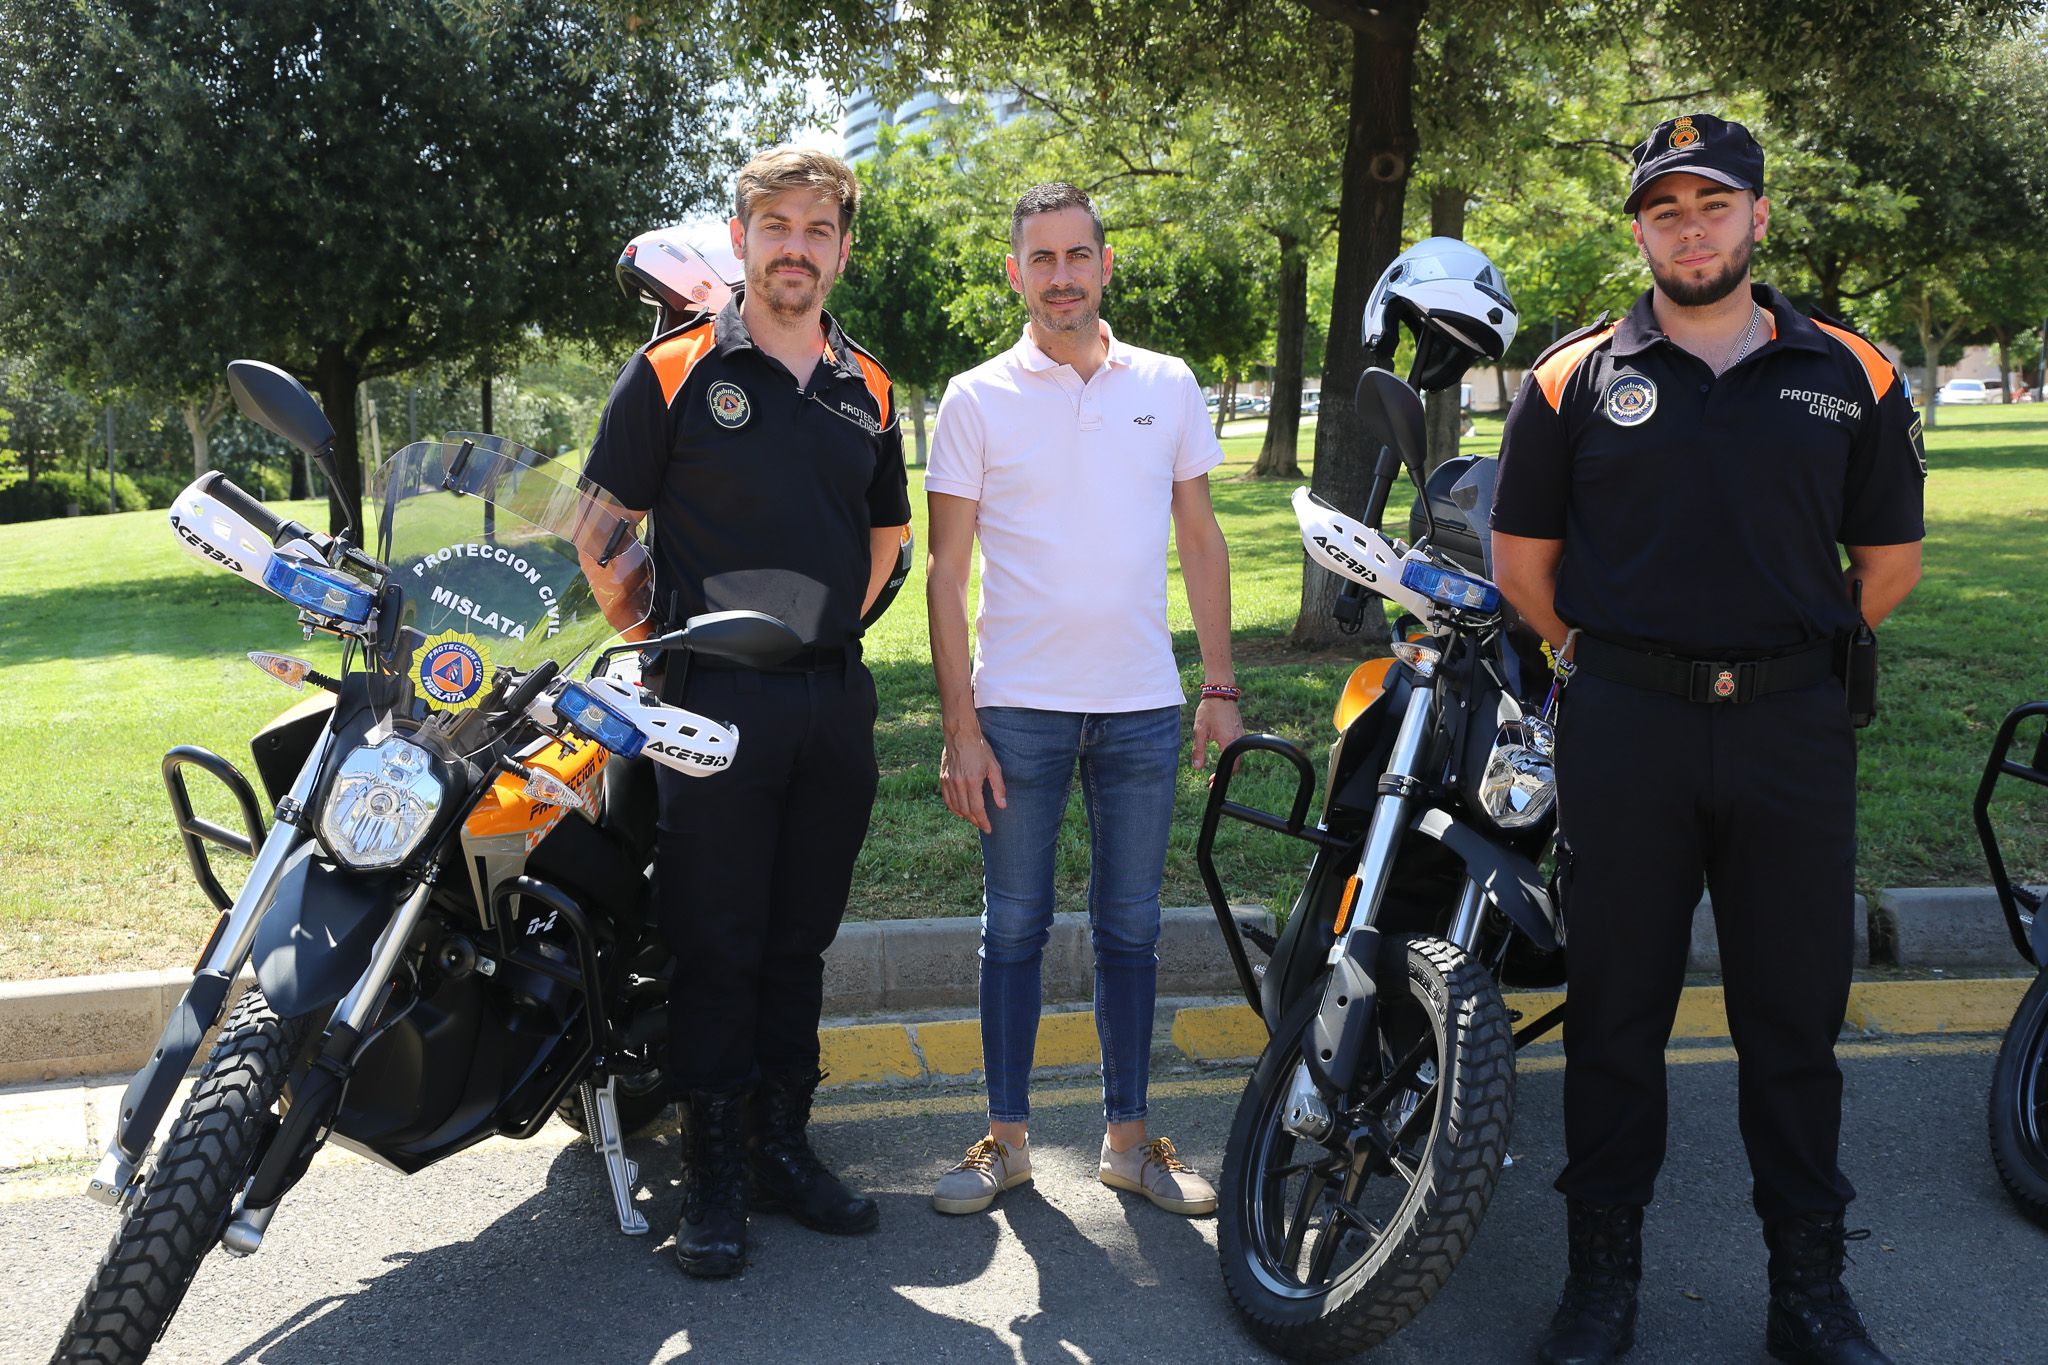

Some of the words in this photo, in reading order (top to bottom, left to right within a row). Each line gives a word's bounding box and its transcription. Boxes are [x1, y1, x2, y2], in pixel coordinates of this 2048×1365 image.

[1808, 403, 1841, 423] CIVIL
[170, 515, 243, 572] ACERBIS
[1312, 536, 1378, 583] ACERBIS
[412, 543, 542, 585] PROTECCION
[538, 585, 560, 639] CIVIL
[430, 585, 526, 642] MISLATA
[427, 643, 478, 661] PROTECCION
[473, 660, 483, 682] CIVIL
[422, 676, 467, 702] MISLATA
[646, 741, 729, 767] ACERBIS
